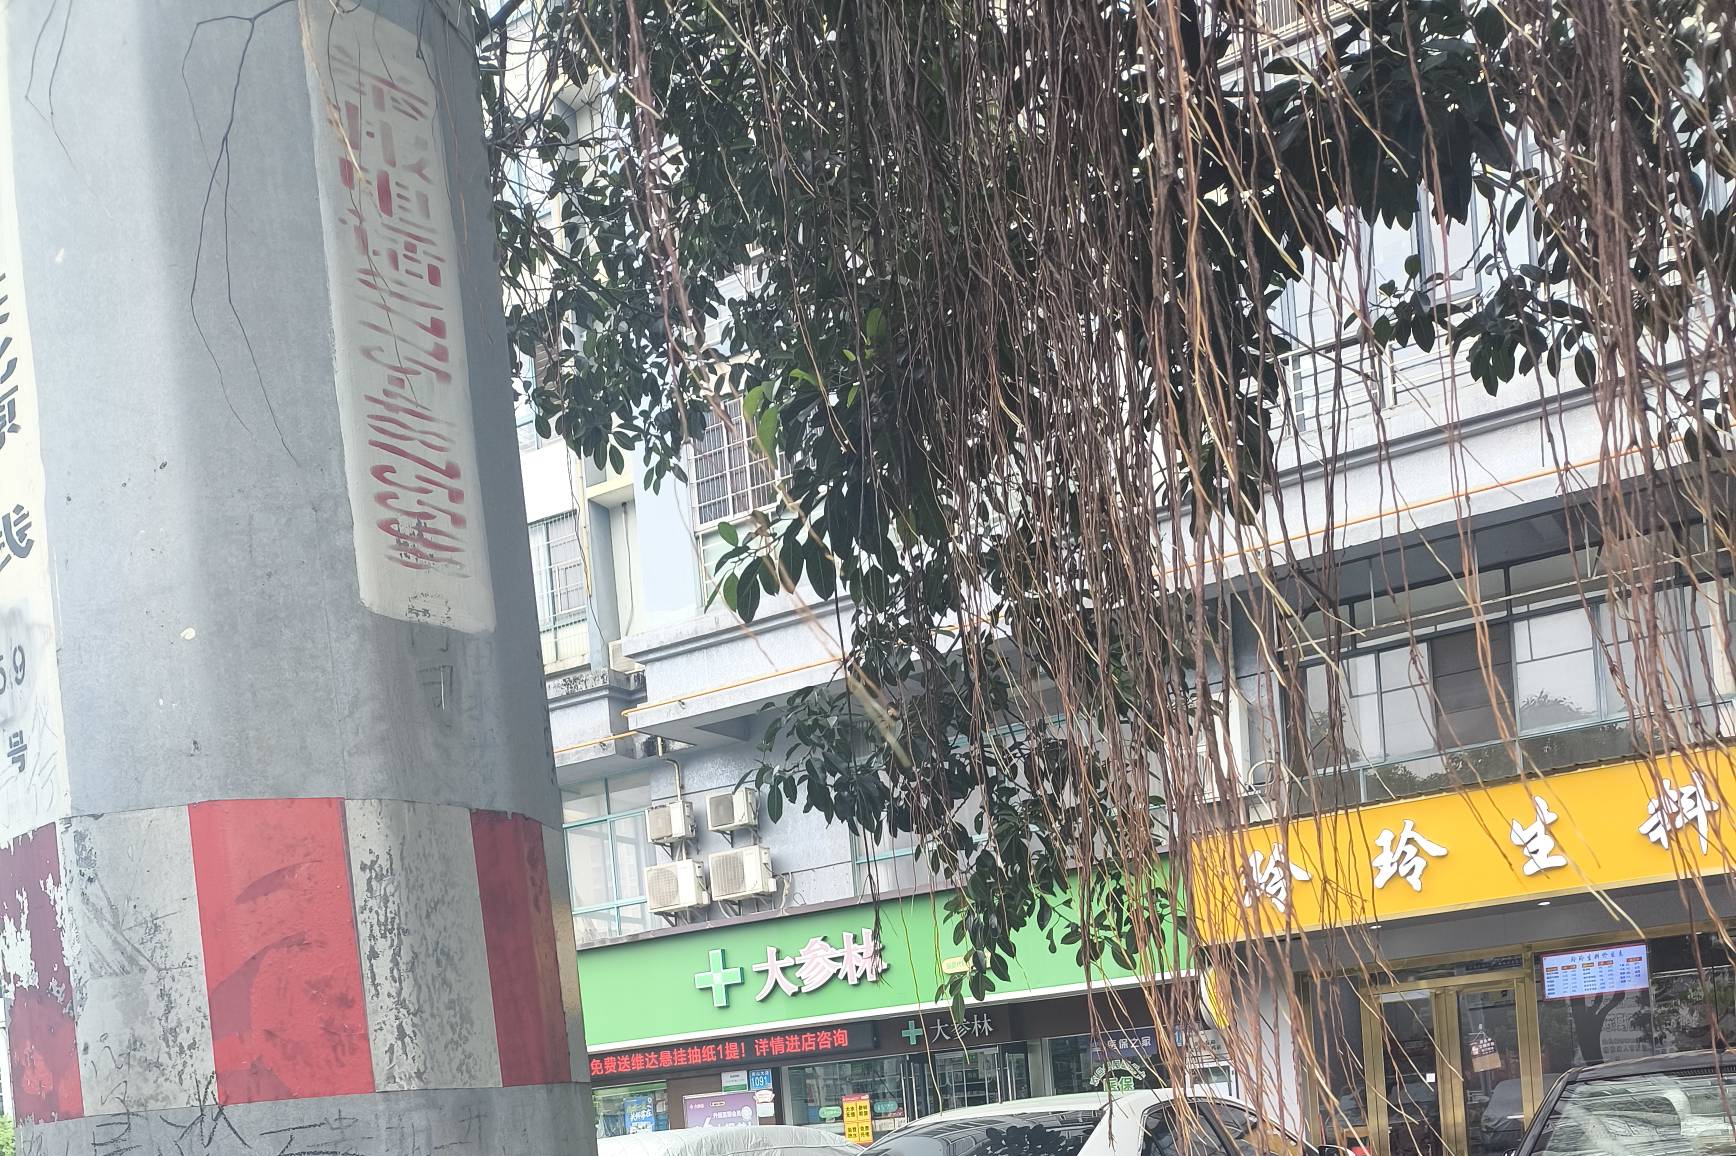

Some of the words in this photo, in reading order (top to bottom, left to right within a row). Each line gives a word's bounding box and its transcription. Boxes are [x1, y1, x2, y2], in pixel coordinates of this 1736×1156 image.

[752, 927, 888, 1002] 大参林
[929, 1013, 994, 1044] 大参林
